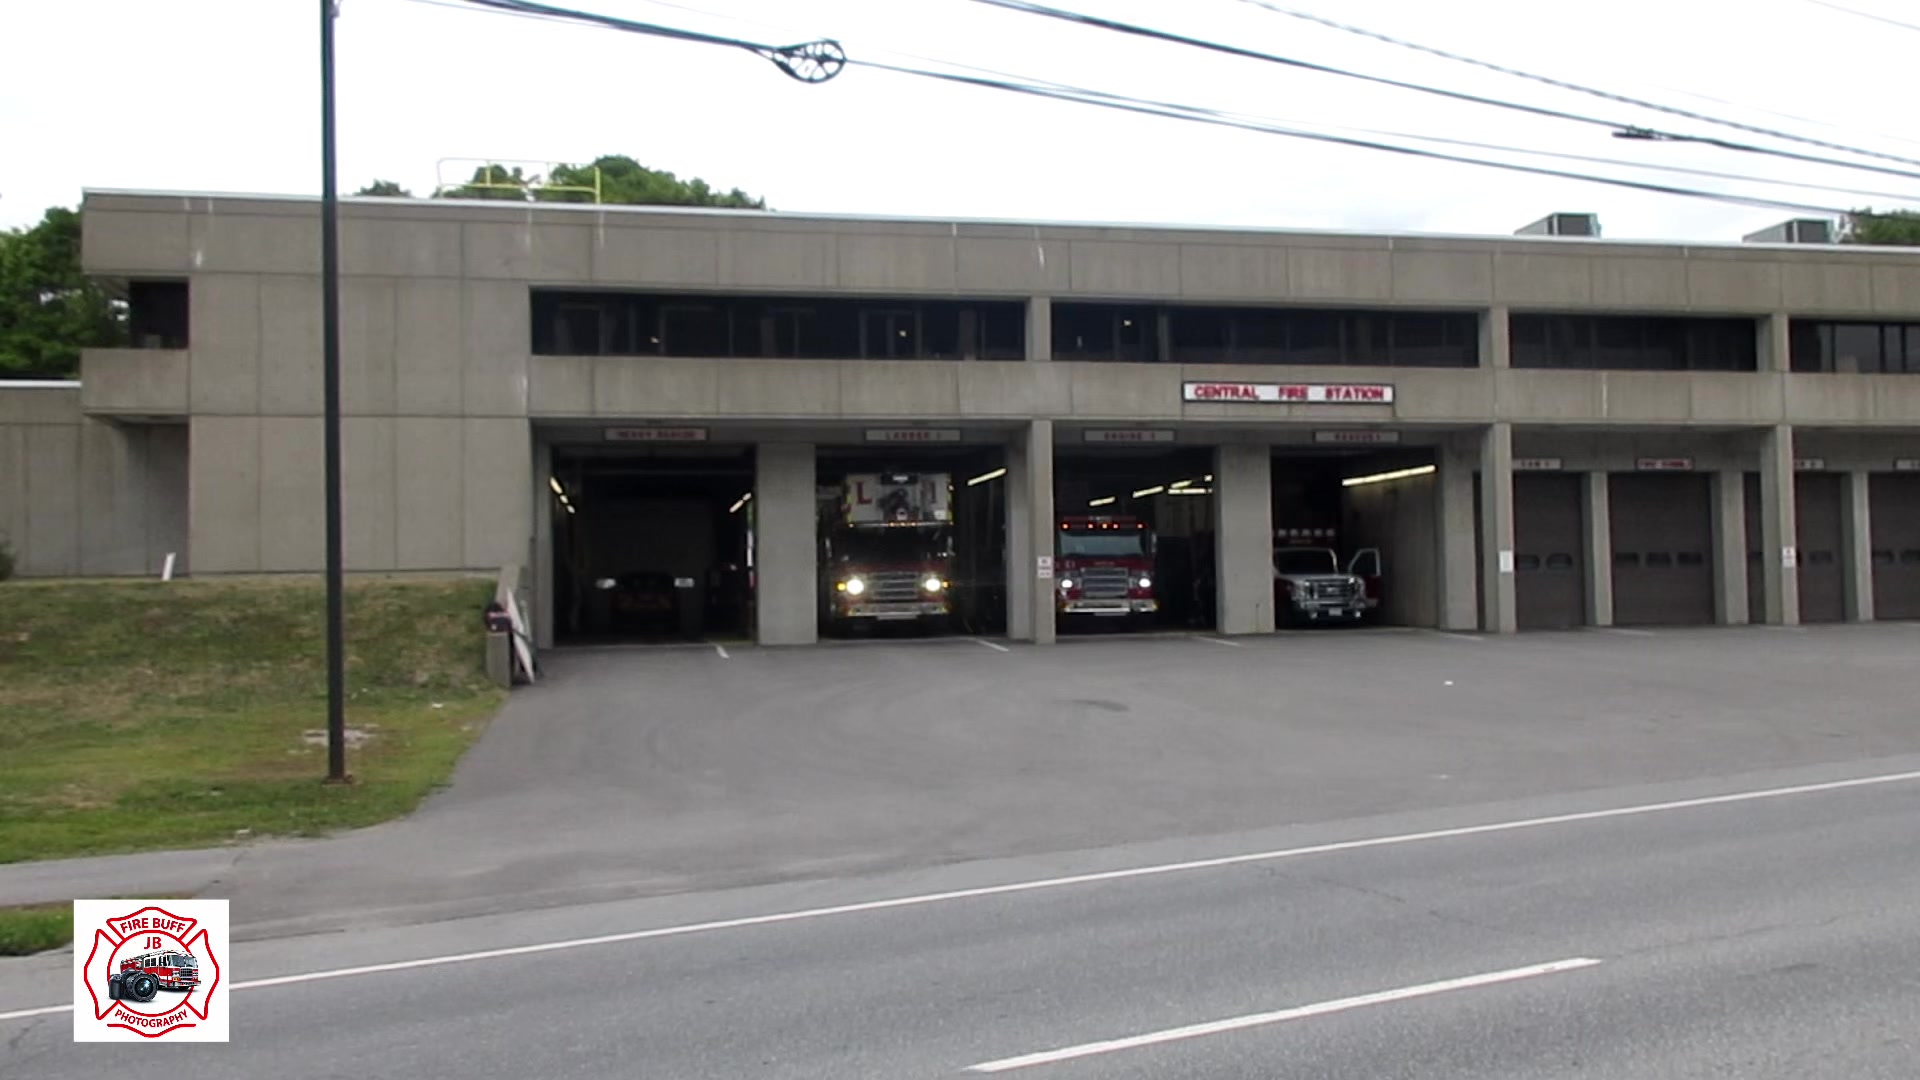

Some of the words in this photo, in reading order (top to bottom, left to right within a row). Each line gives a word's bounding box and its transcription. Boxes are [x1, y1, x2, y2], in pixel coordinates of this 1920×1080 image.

[1194, 384, 1259, 400] CENTRAL
[1278, 385, 1308, 400] FIRE
[1325, 386, 1384, 400] STATION
[856, 481, 873, 505] L
